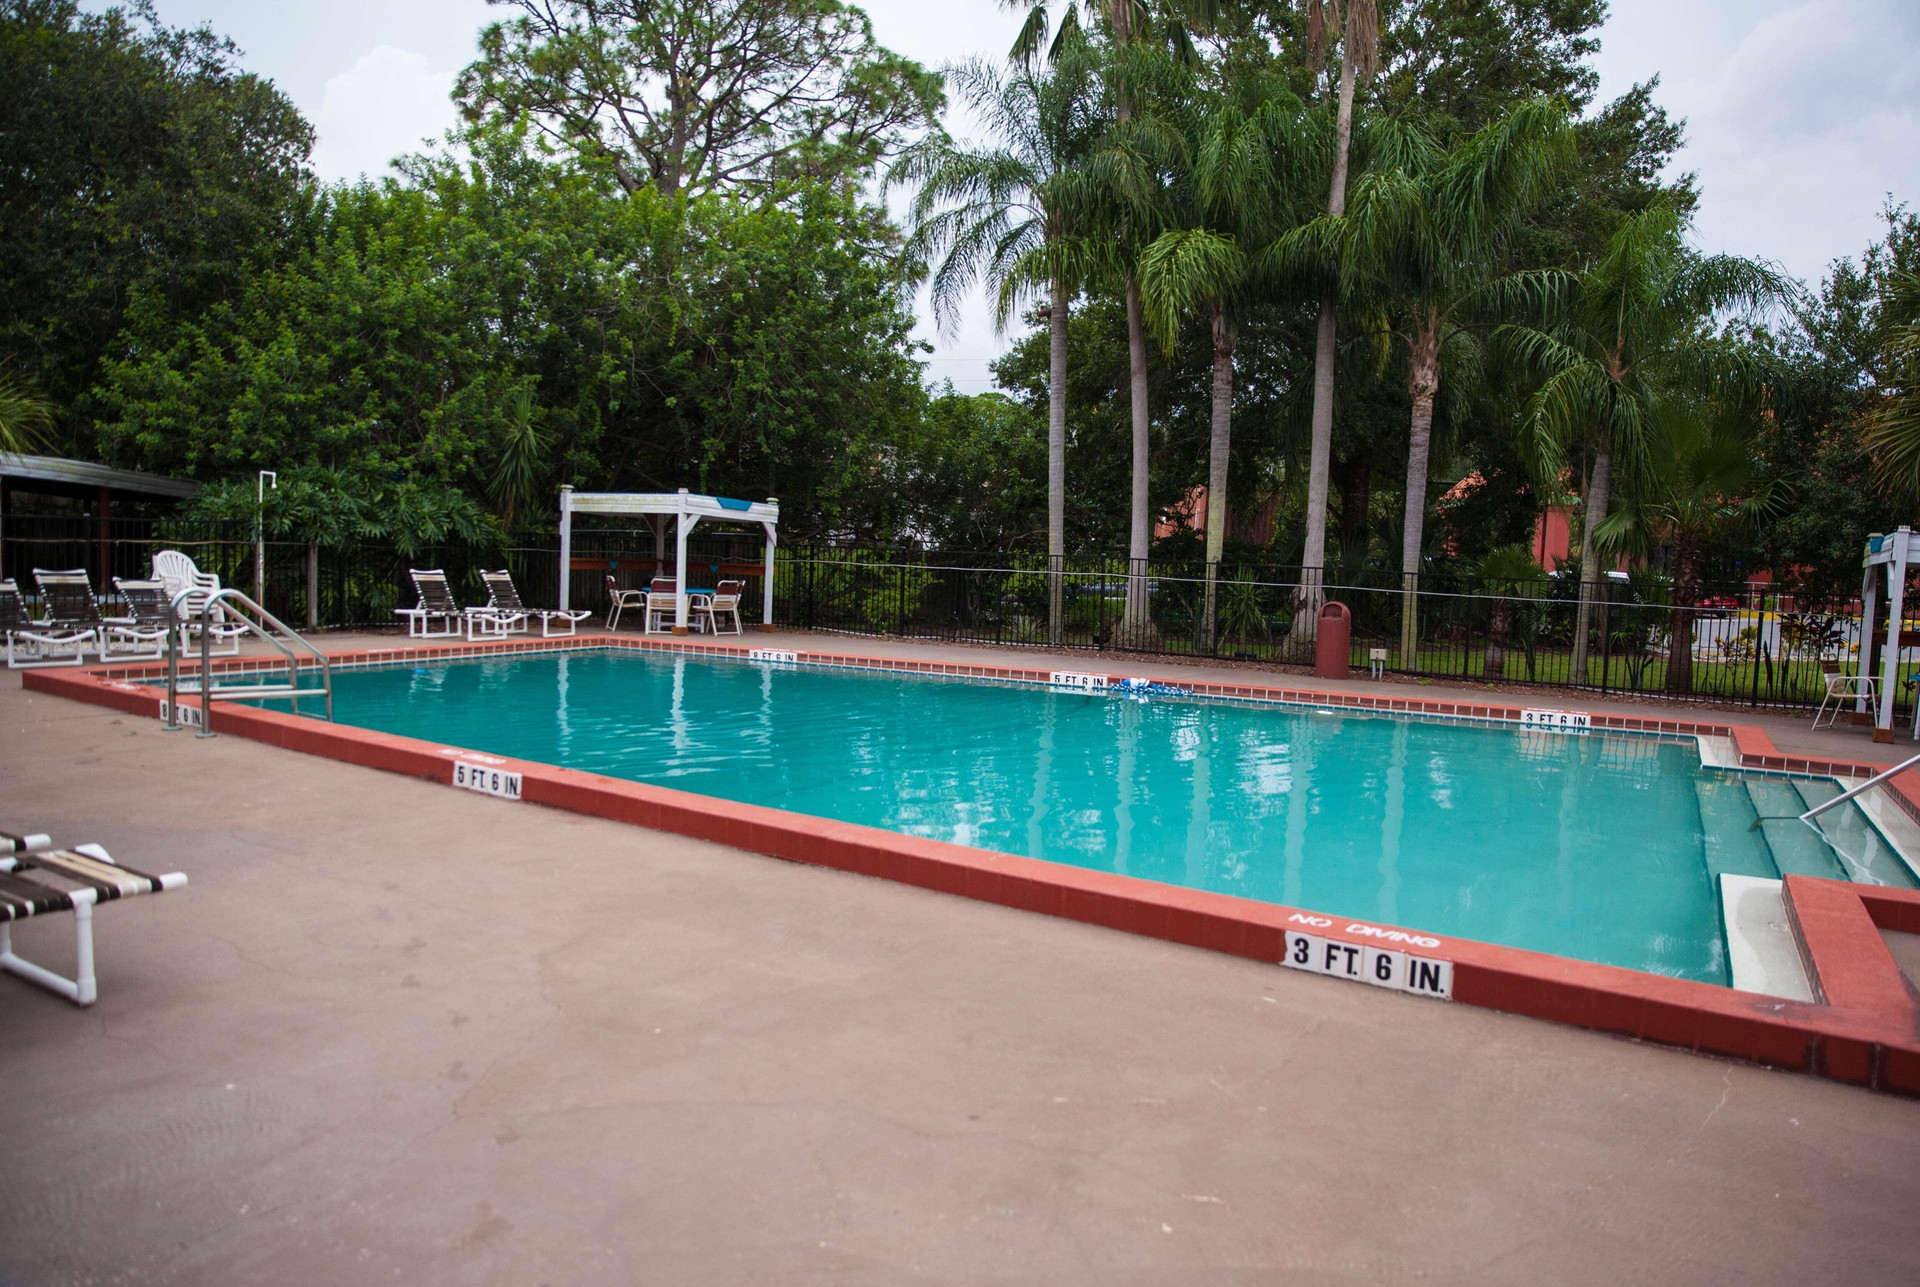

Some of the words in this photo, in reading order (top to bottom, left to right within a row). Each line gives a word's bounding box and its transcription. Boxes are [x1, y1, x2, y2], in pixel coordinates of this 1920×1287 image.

[1054, 674, 1061, 684] 5
[1526, 712, 1534, 722] 3
[1560, 715, 1568, 725] 6
[458, 765, 466, 784] 5
[492, 773, 500, 792] 6
[1288, 913, 1333, 928] NO
[1345, 923, 1441, 948] DIVING
[1294, 938, 1309, 964] 3
[1325, 943, 1359, 976] FT.
[1375, 953, 1392, 981] 6
[1409, 959, 1445, 994] IN.
